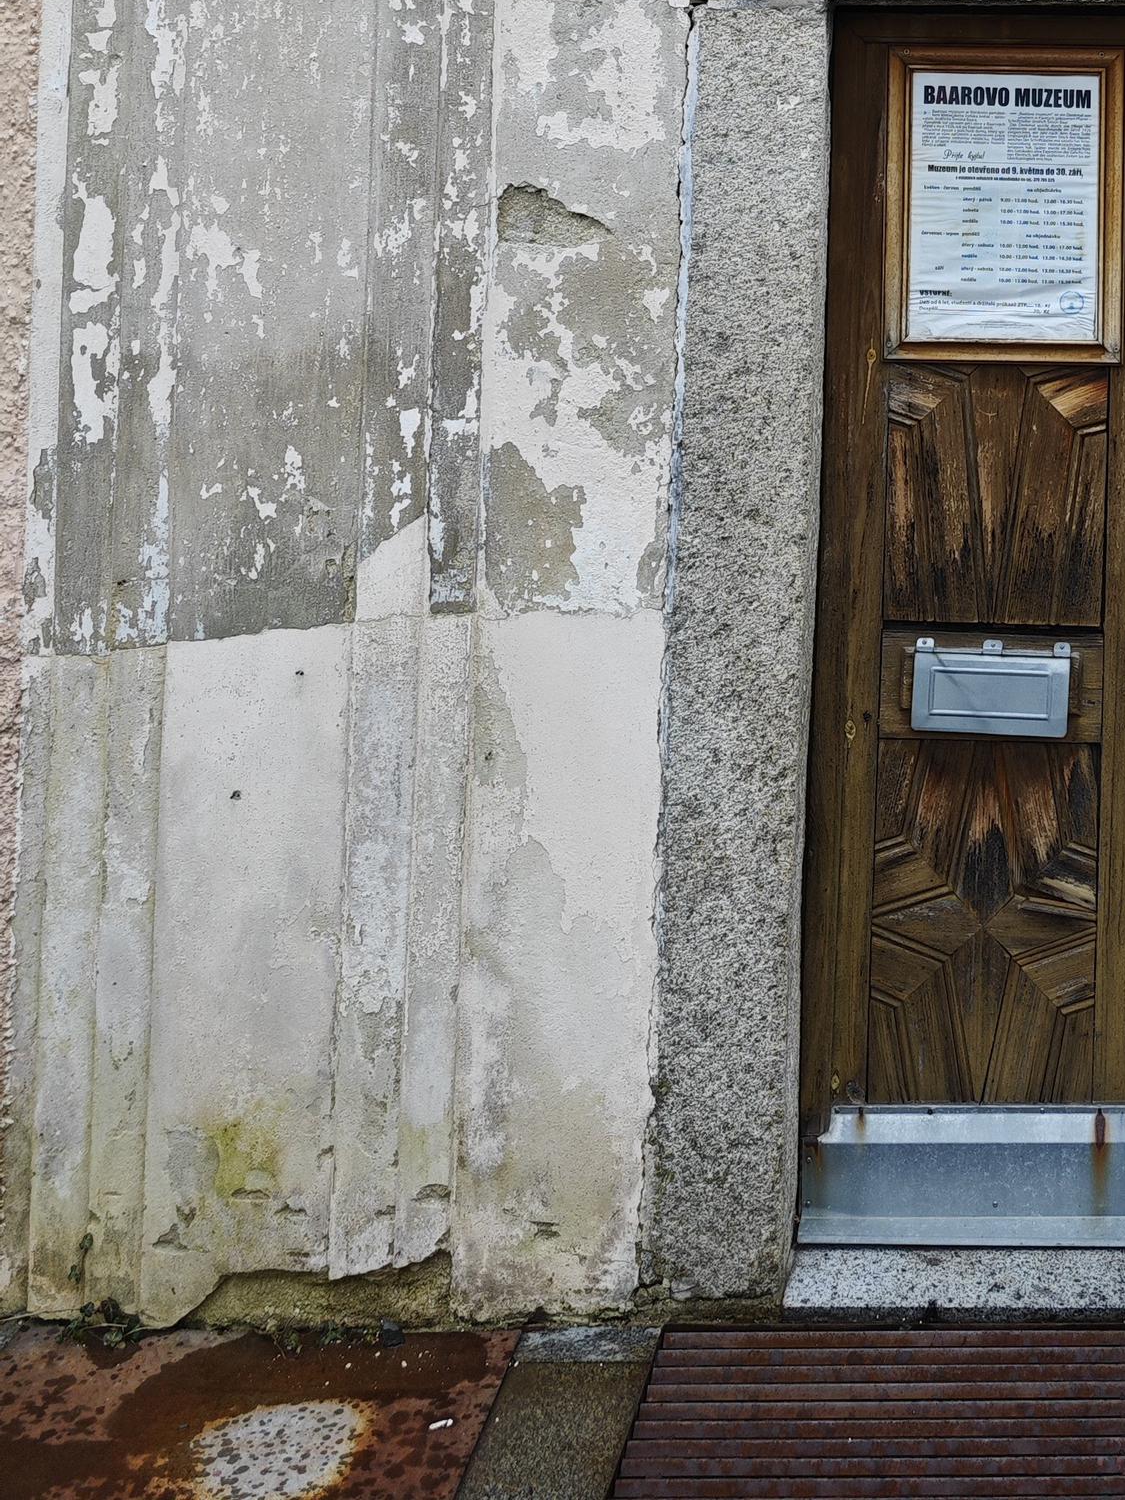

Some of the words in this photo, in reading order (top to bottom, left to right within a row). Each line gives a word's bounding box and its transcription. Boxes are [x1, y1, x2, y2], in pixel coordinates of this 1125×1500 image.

[924, 85, 1009, 107] BAAROVO
[1015, 88, 1091, 108] MUZEUM
[928, 165, 957, 173] Muzeum
[959, 165, 966, 173] je
[968, 166, 999, 174] otevřeno
[1020, 167, 1044, 175] května
[1056, 168, 1068, 176] 30.
